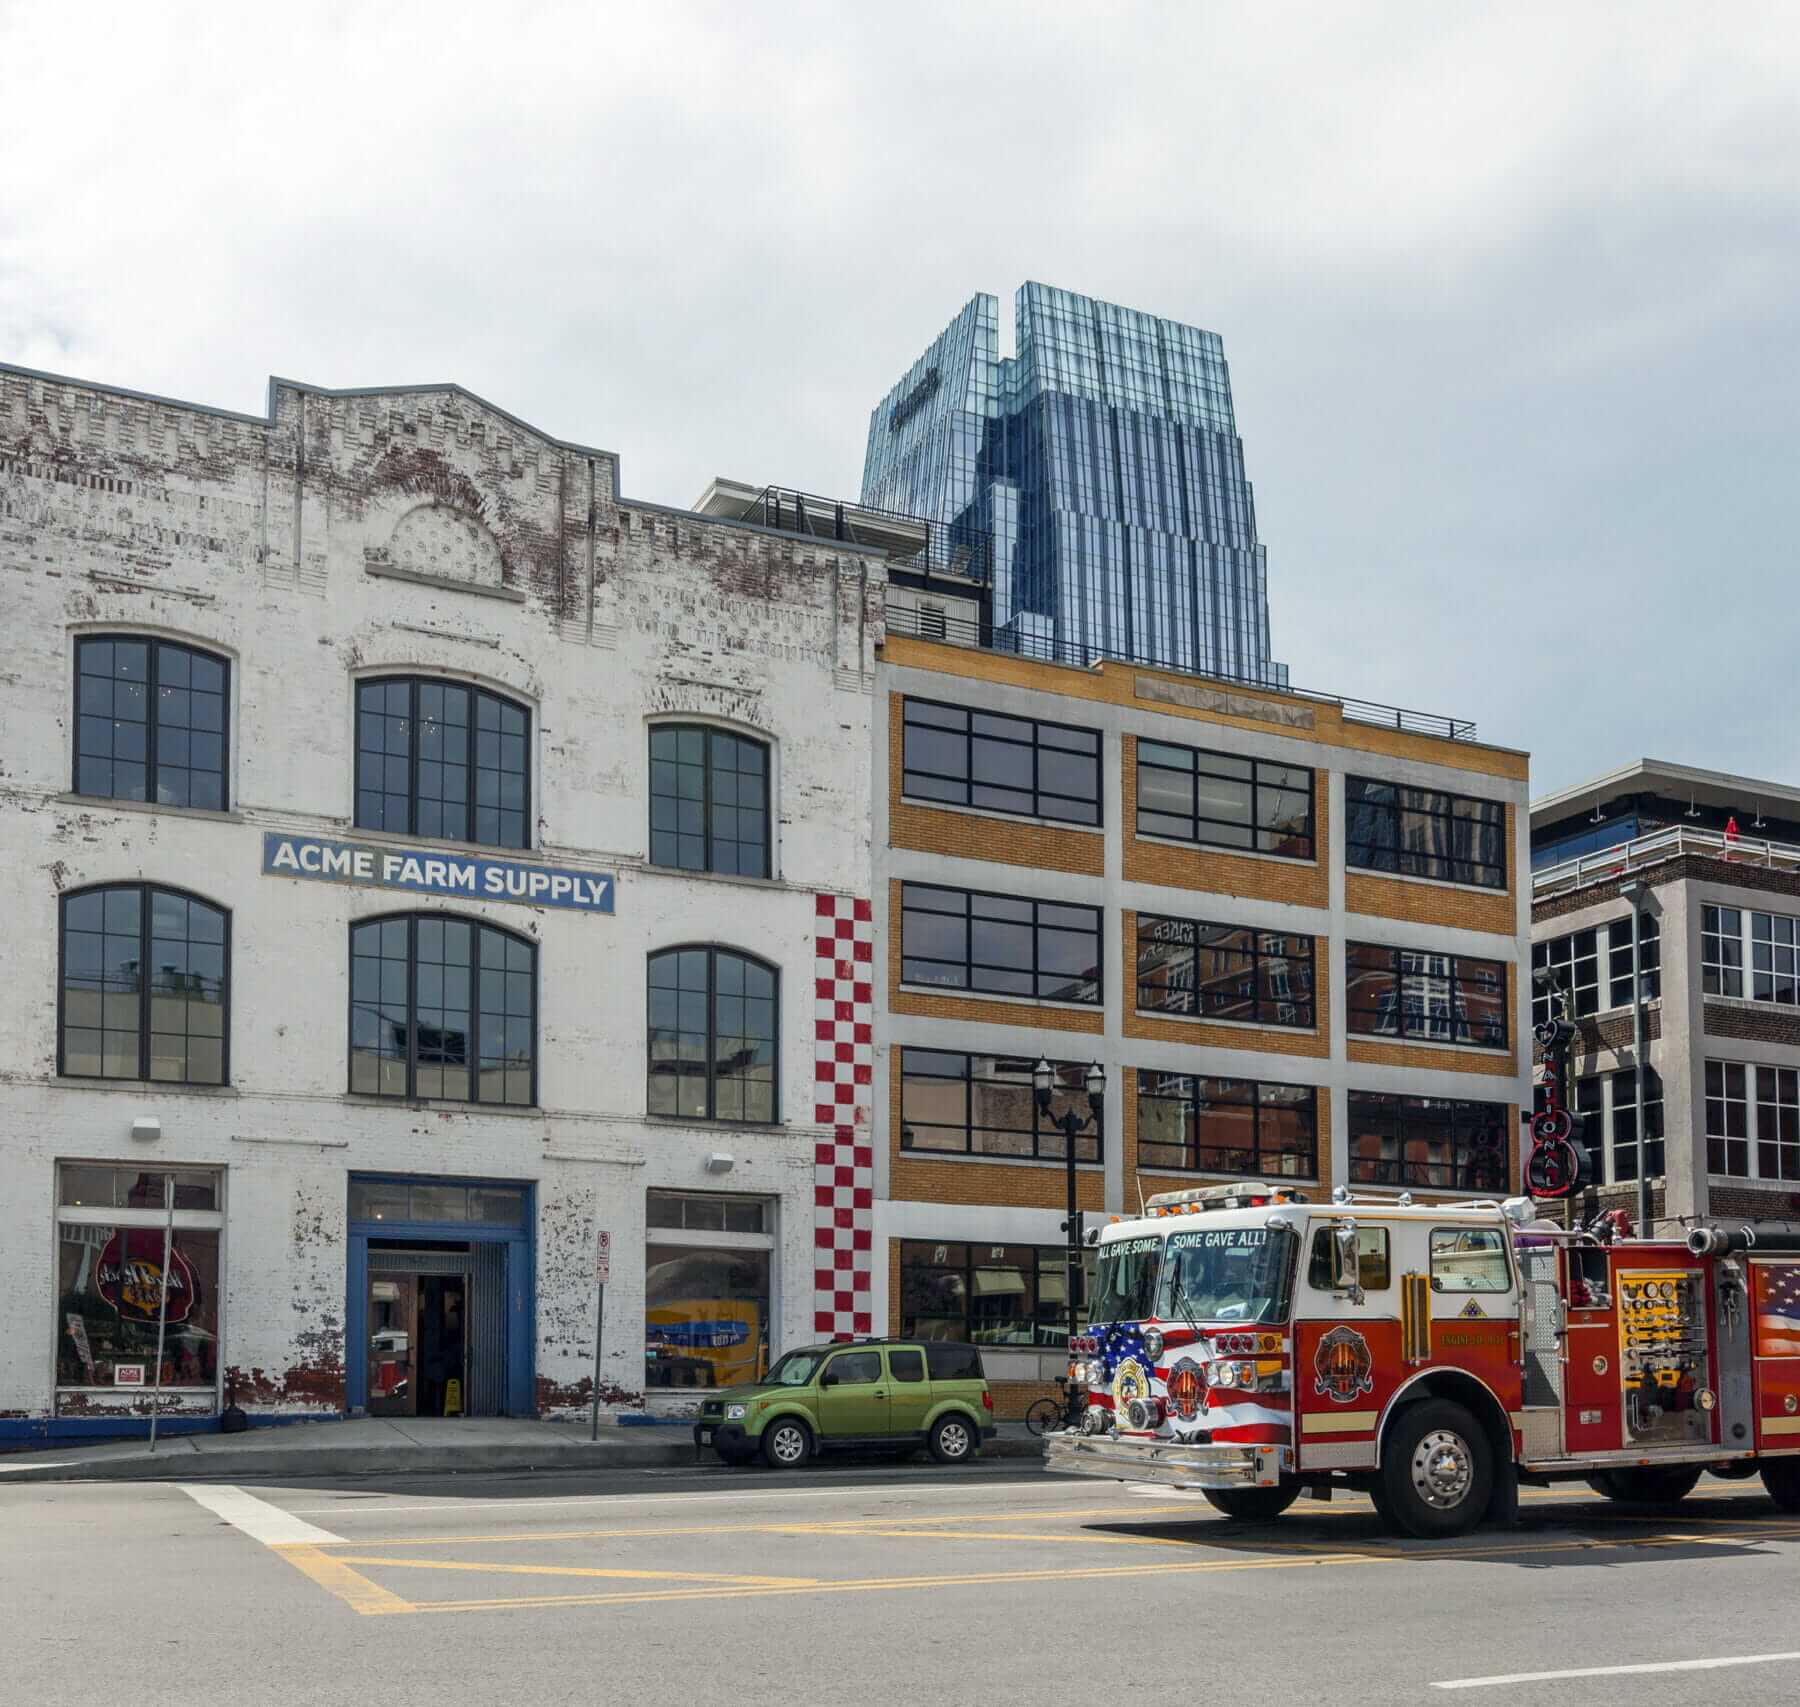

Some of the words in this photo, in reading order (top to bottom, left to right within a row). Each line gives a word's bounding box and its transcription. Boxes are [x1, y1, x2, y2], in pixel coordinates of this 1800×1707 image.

[272, 842, 373, 878] ACME
[383, 854, 475, 891] FARM
[484, 866, 607, 905] SUPPLY
[1111, 1244, 1131, 1257] GAVE
[1131, 1238, 1158, 1254] SOME
[1174, 1234, 1201, 1249] SOME
[1205, 1232, 1235, 1248] GAVE
[1238, 1231, 1267, 1246] ALL!
